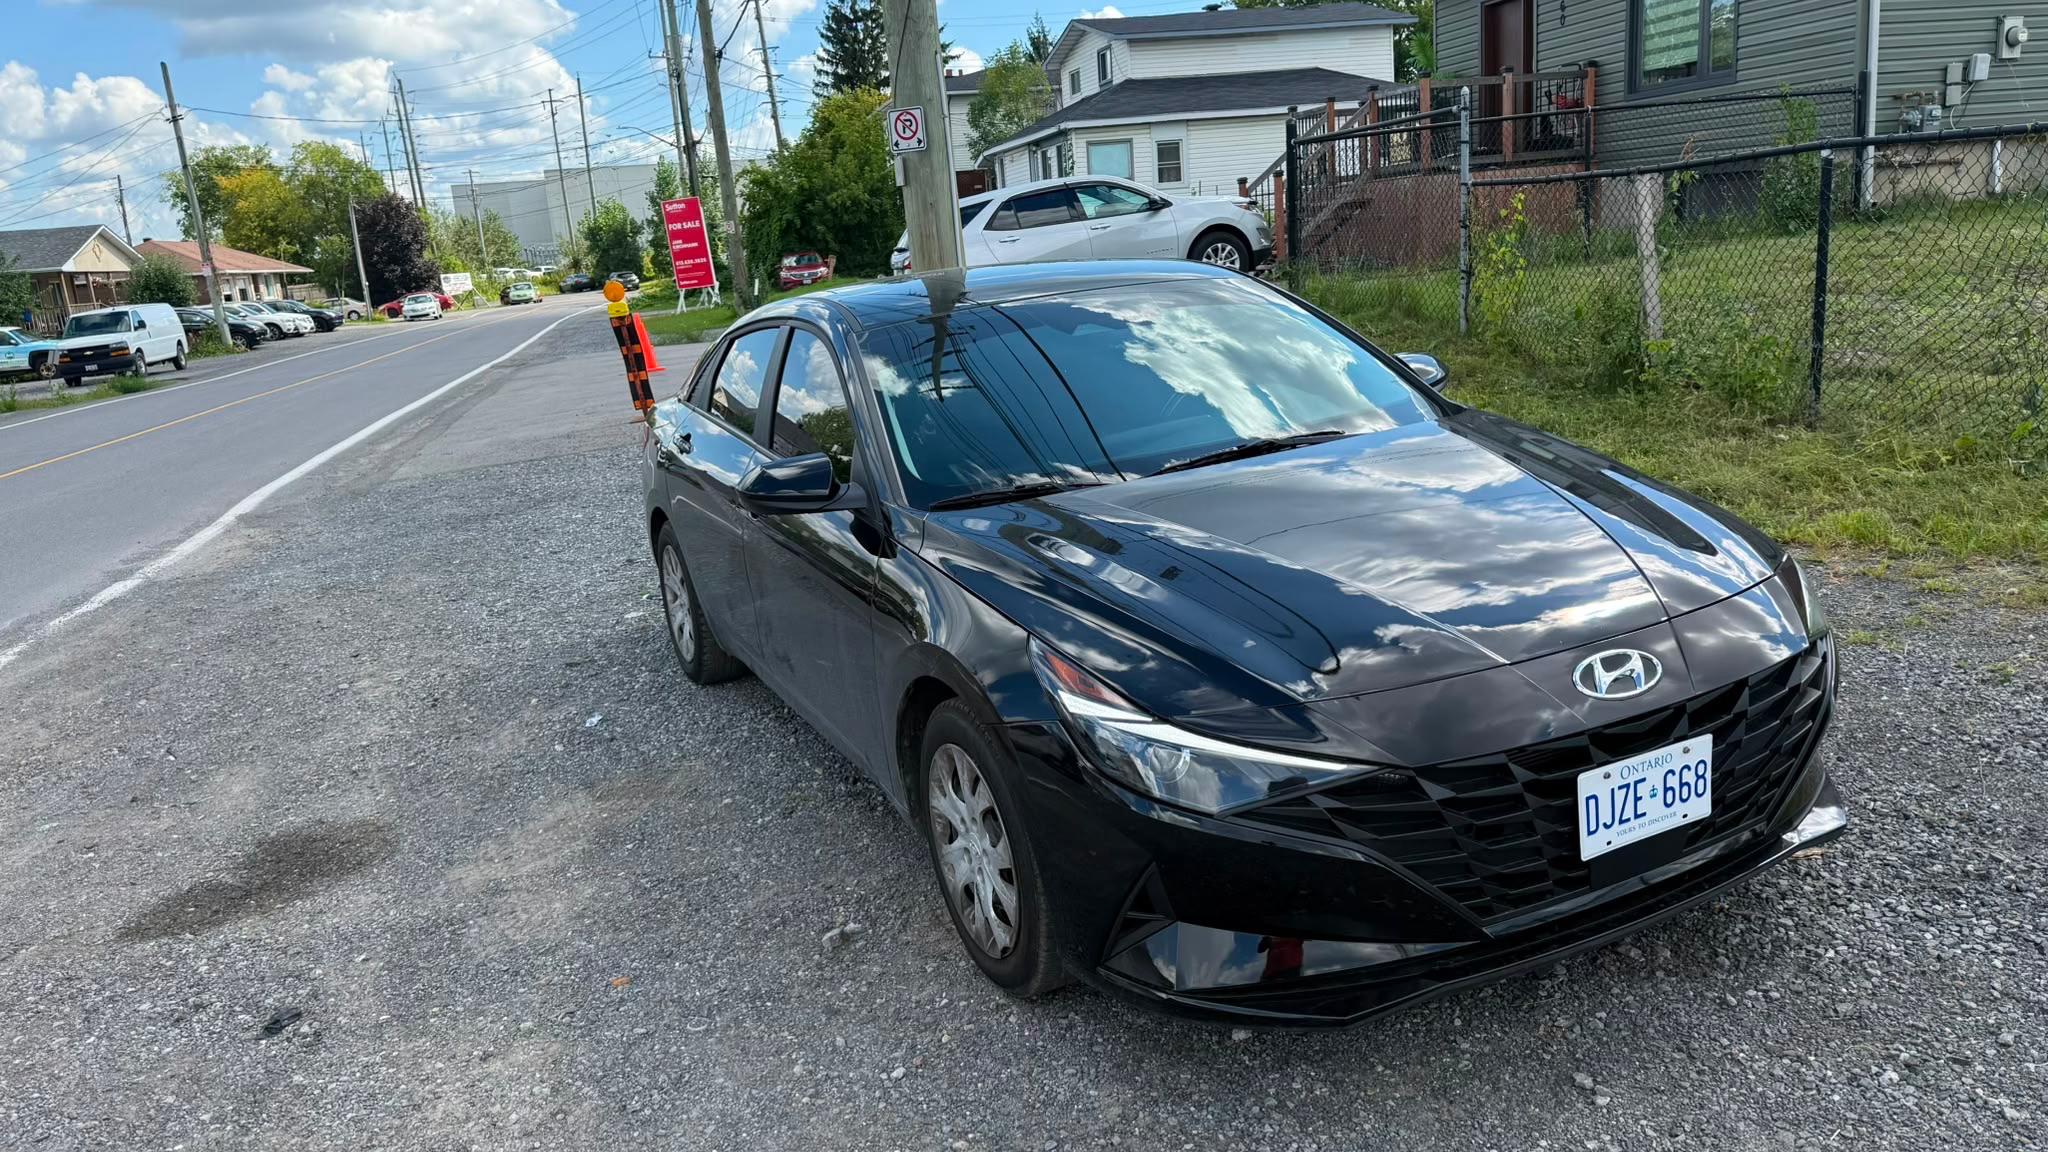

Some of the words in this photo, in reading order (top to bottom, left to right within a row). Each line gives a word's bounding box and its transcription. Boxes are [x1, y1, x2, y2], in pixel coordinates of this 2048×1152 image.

[668, 222, 682, 230] FOR
[682, 220, 700, 229] SALE
[1620, 753, 1673, 780] ONTARIO
[1585, 777, 1647, 837] DJZE
[1663, 759, 1708, 808] 668
[1616, 826, 1637, 838] YOURS
[1638, 821, 1647, 830] TO
[1647, 811, 1678, 827] DISCOVER
